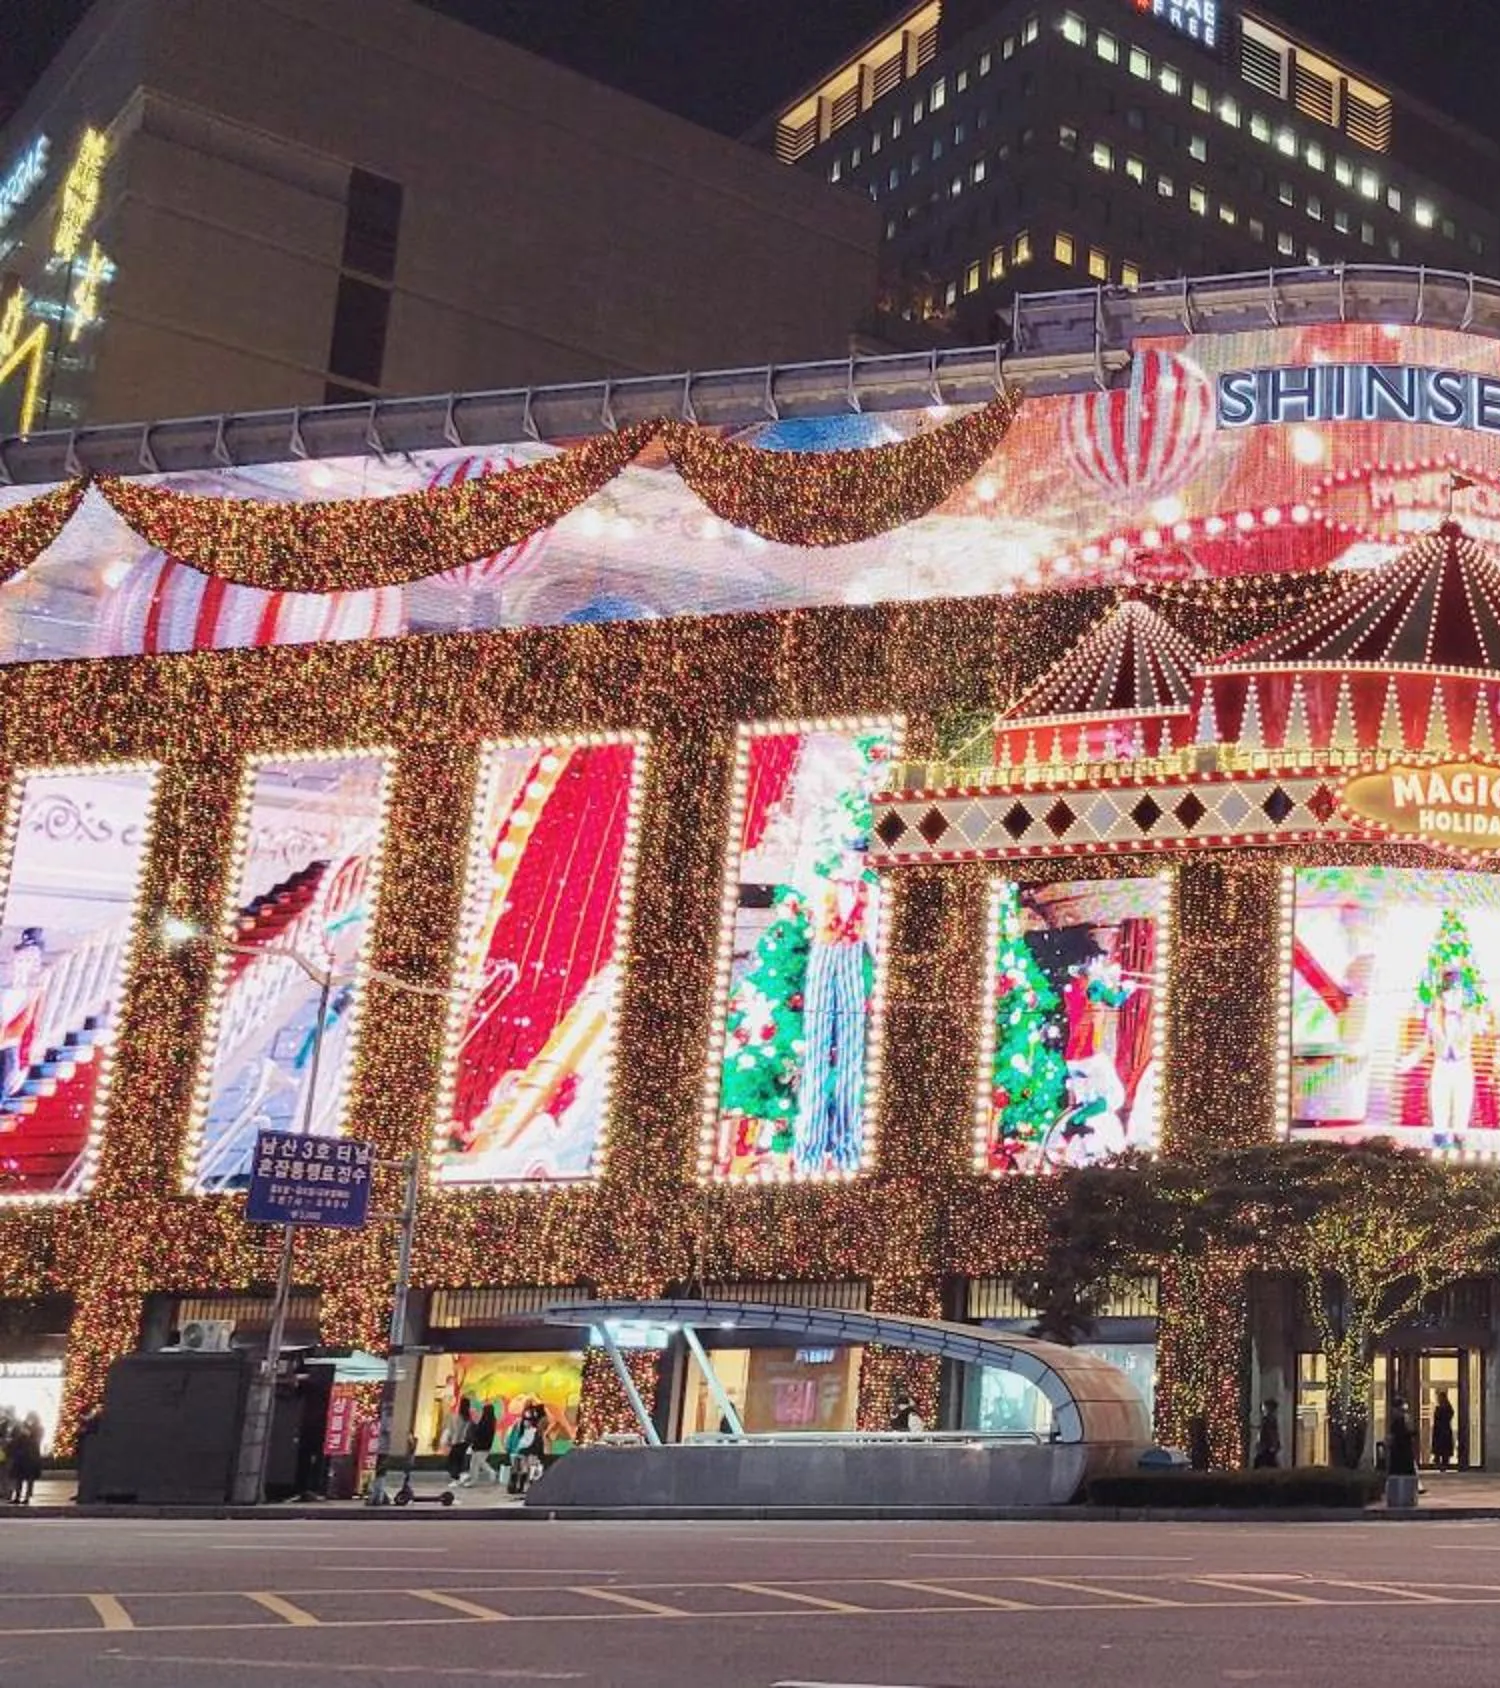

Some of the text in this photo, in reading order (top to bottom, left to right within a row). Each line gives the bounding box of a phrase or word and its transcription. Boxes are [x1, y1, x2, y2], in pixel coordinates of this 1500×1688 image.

[261, 1135, 370, 1164] 남산 3호 터널
[258, 1157, 367, 1185] 혼잡통행료징수
